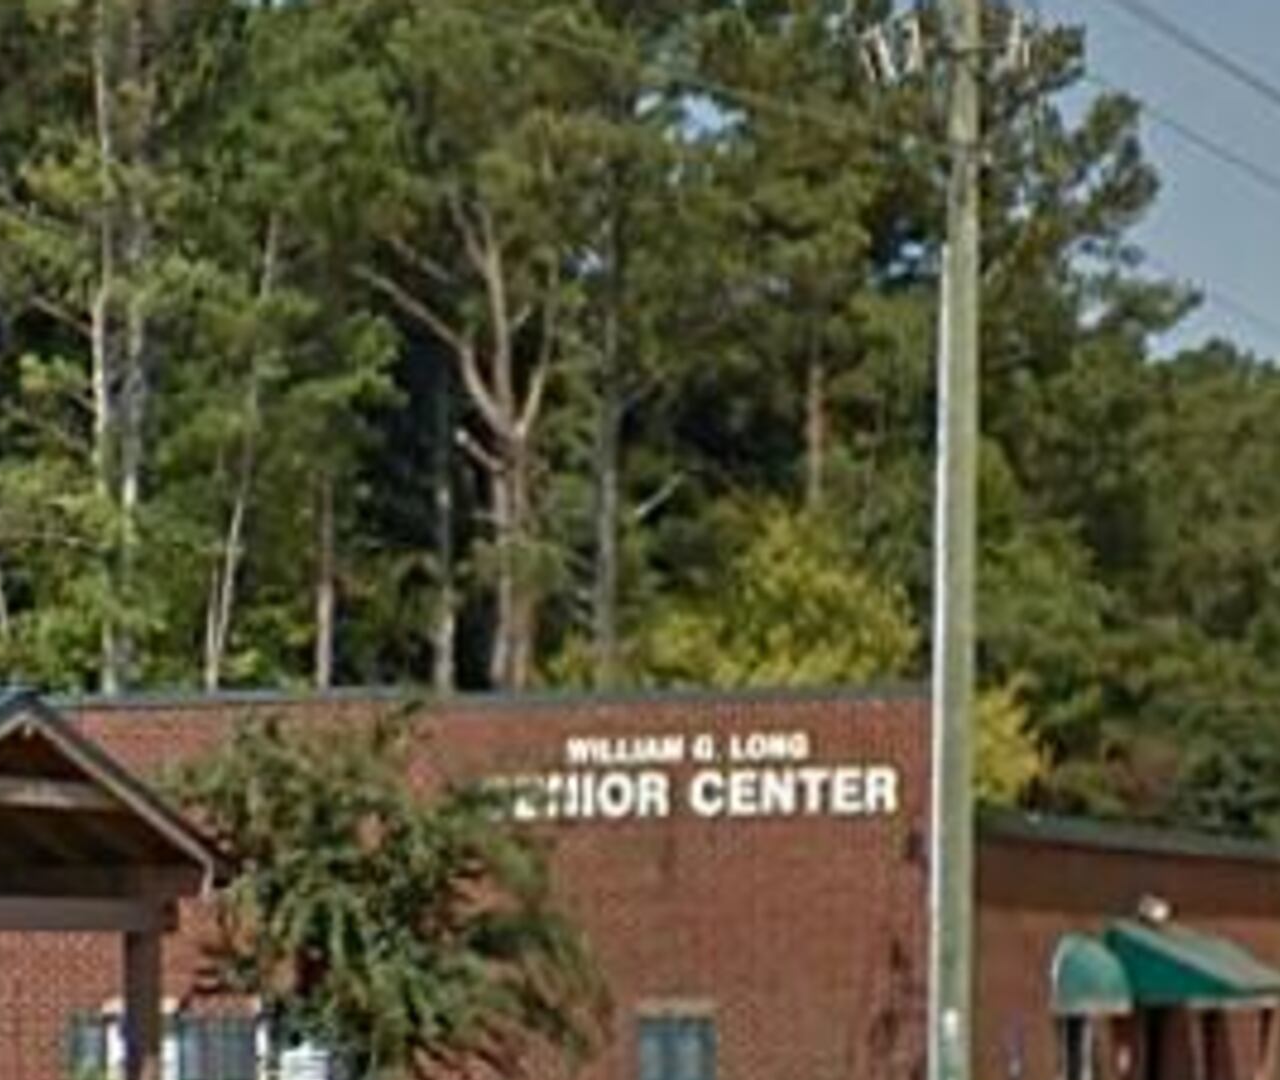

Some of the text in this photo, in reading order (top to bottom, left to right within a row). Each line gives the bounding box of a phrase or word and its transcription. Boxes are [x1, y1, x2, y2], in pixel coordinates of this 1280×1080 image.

[566, 735, 685, 764] WILLIAM
[729, 732, 810, 760] LONG
[484, 766, 898, 819] ENIOR CENTER
